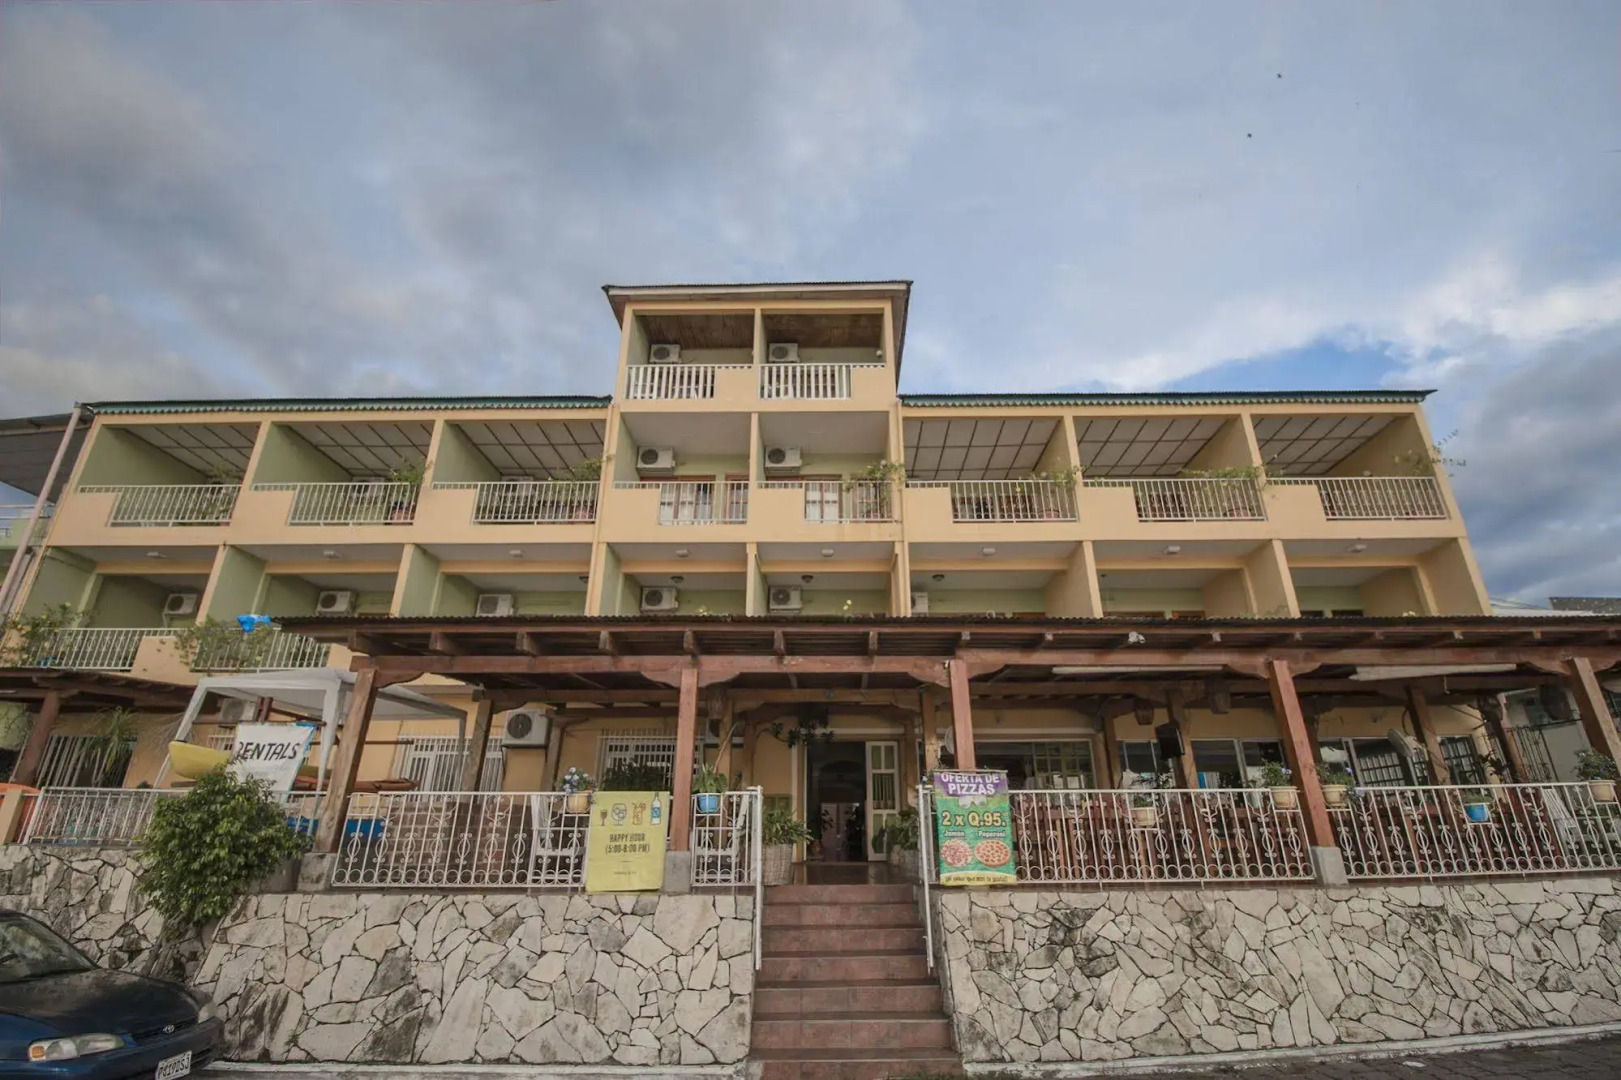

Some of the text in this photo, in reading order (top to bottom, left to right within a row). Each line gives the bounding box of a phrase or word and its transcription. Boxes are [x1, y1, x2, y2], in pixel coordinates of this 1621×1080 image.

[941, 773, 1000, 783] OFERTA DE
[948, 783, 995, 795] PIZZAS
[942, 811, 951, 826] 2
[610, 833, 645, 842] HAPPY HOUR
